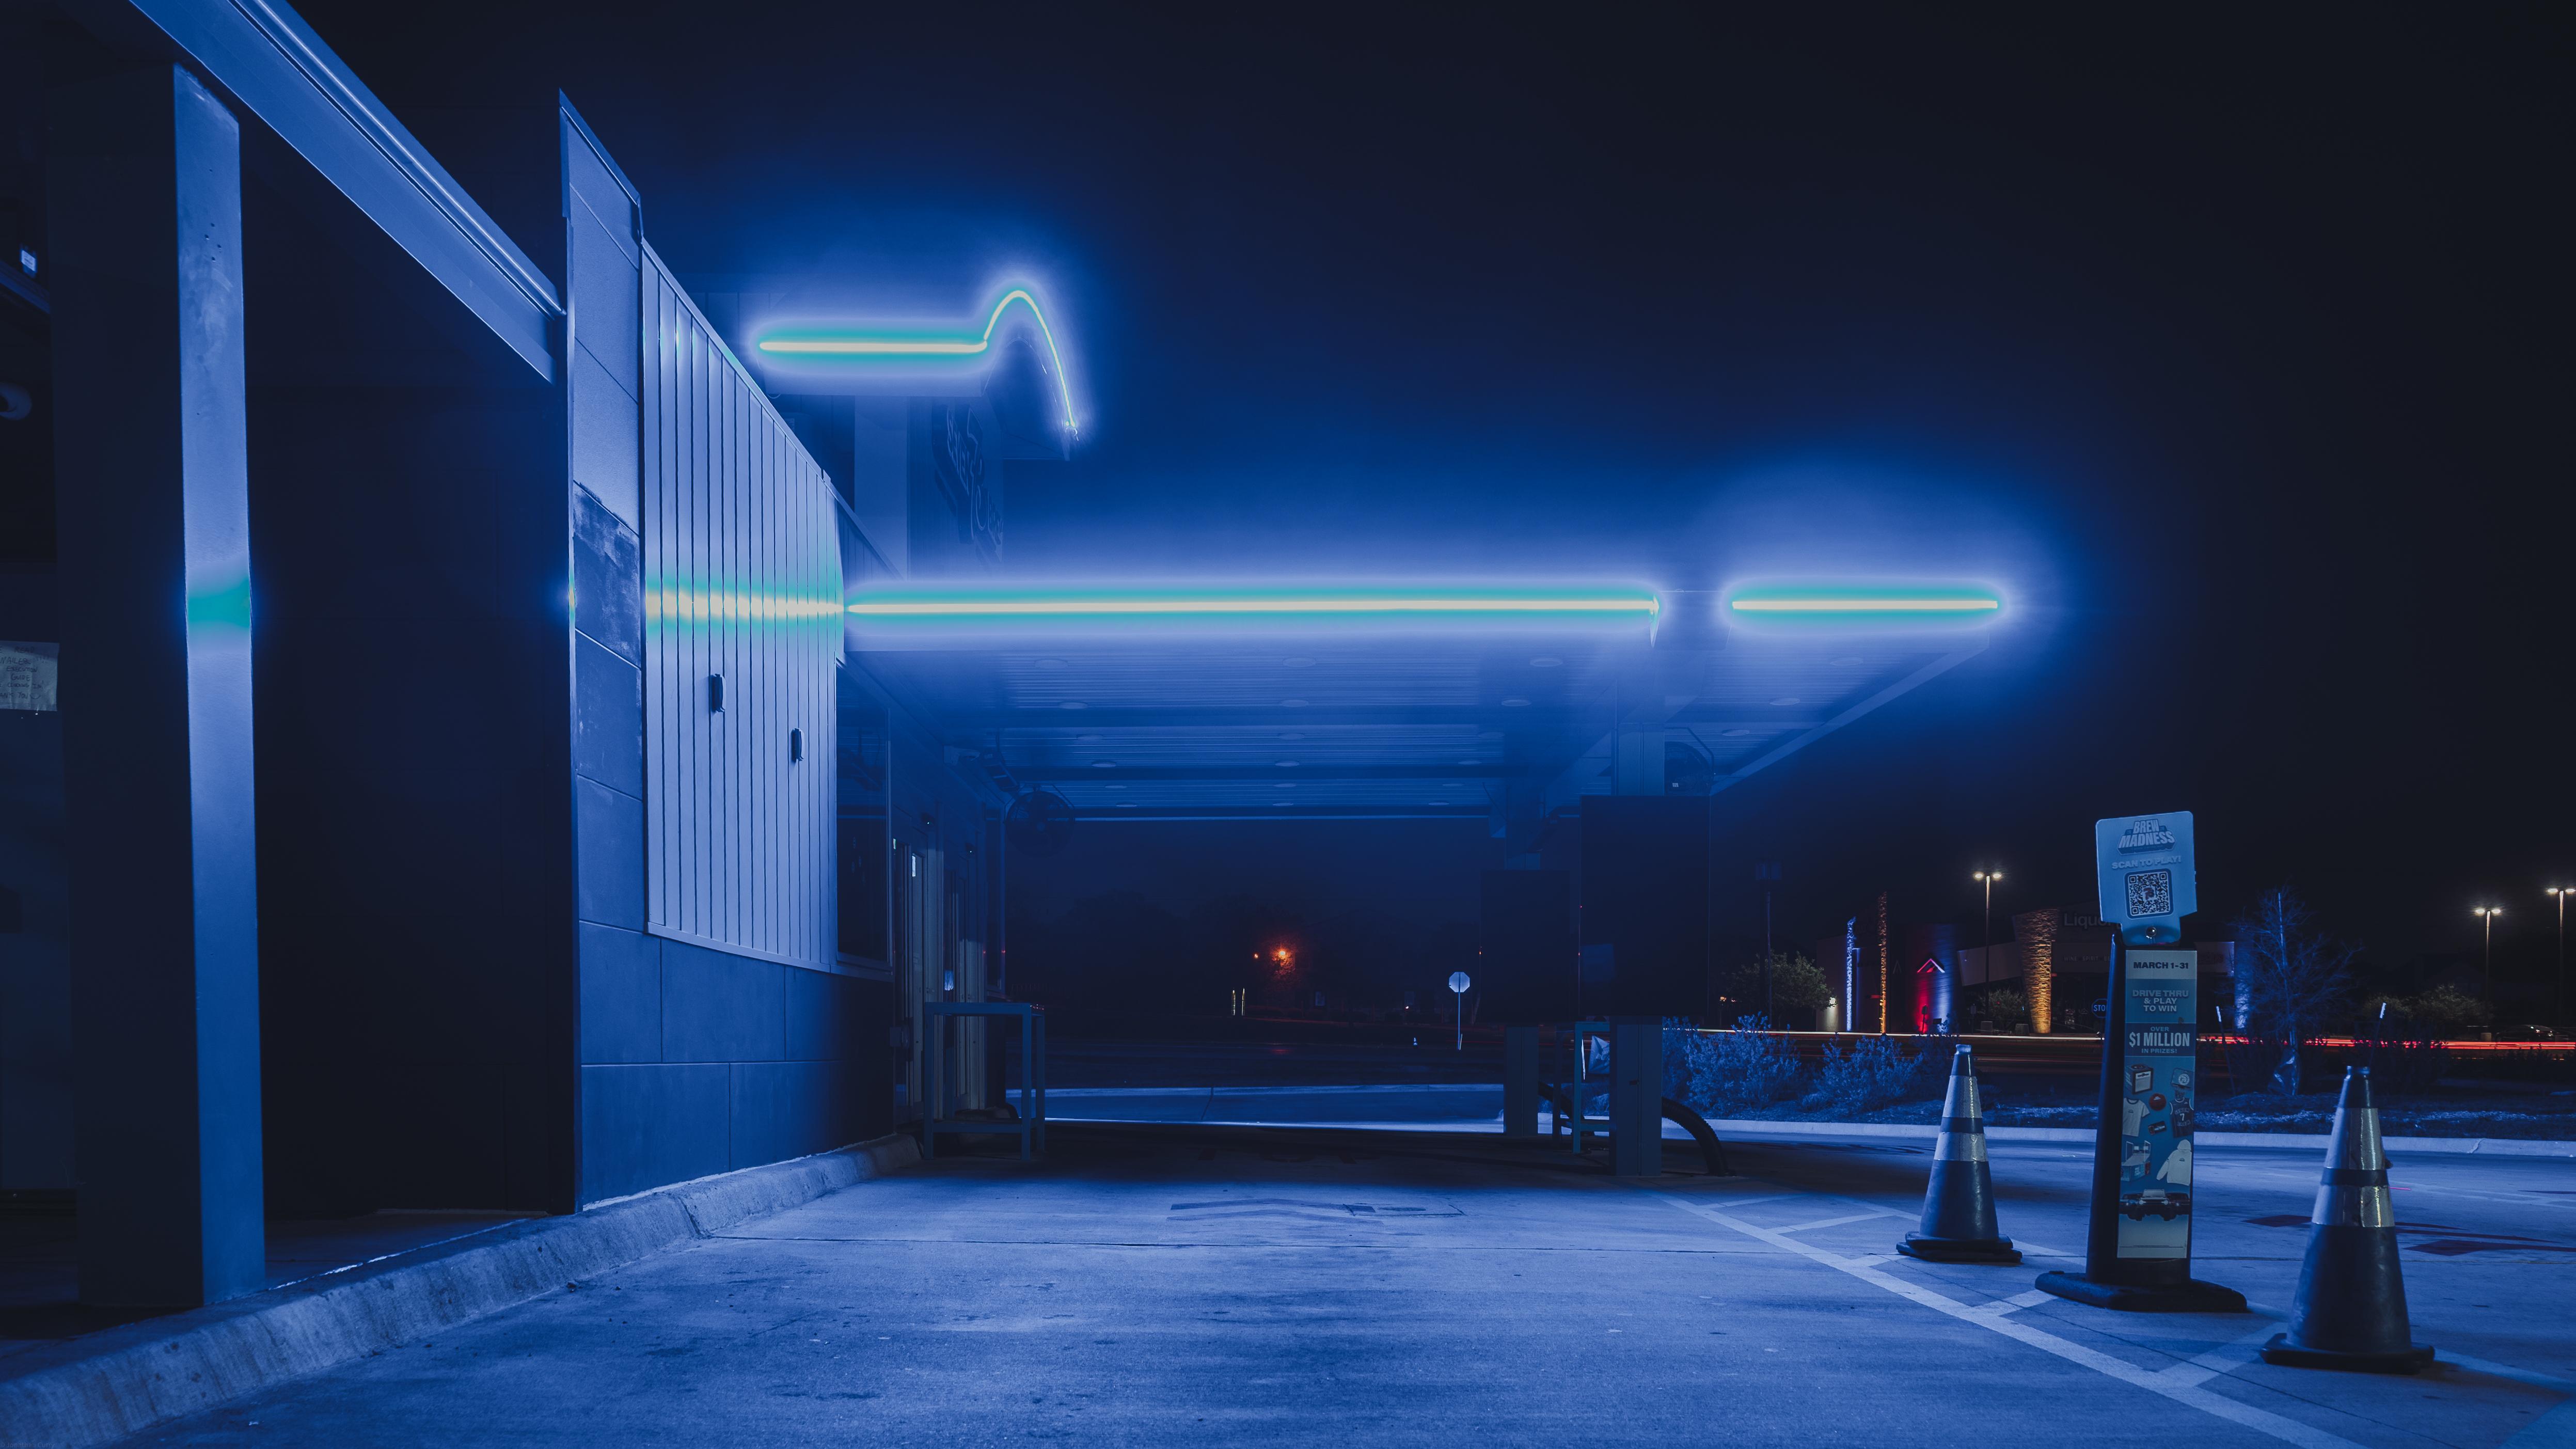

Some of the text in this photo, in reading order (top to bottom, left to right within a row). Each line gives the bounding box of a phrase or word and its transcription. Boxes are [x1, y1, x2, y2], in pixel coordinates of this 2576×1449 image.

[11, 673, 30, 681] GUIDE
[18, 691, 29, 699] YOU
[2133, 820, 2160, 834] BREW
[2118, 831, 2175, 848] MADNESS
[2111, 860, 2139, 870] SCAN
[2154, 855, 2182, 865] PLAY!
[2129, 1032, 2190, 1047] $1 MILLION
[2179, 1113, 2185, 1122] 7
